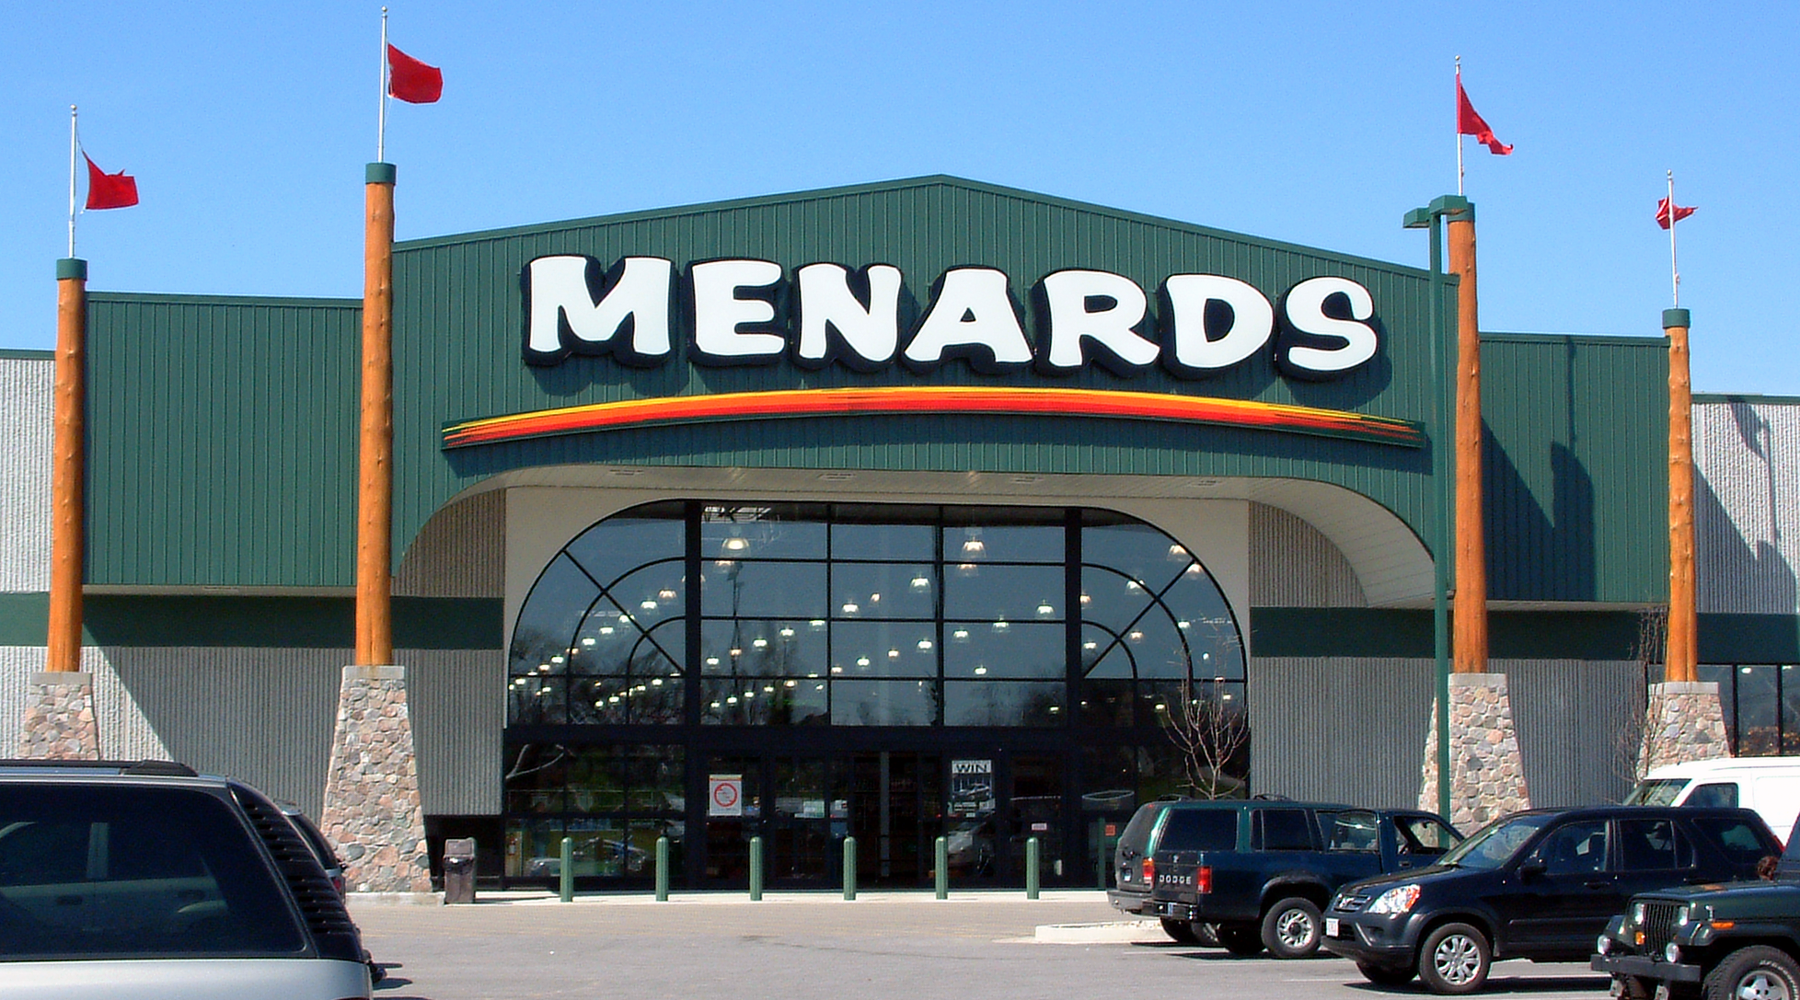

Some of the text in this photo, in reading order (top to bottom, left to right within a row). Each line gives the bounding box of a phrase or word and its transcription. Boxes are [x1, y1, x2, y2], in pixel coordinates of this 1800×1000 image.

[527, 254, 1379, 373] MENARDS
[956, 764, 988, 772] WIN
[1159, 875, 1192, 885] DODGE
